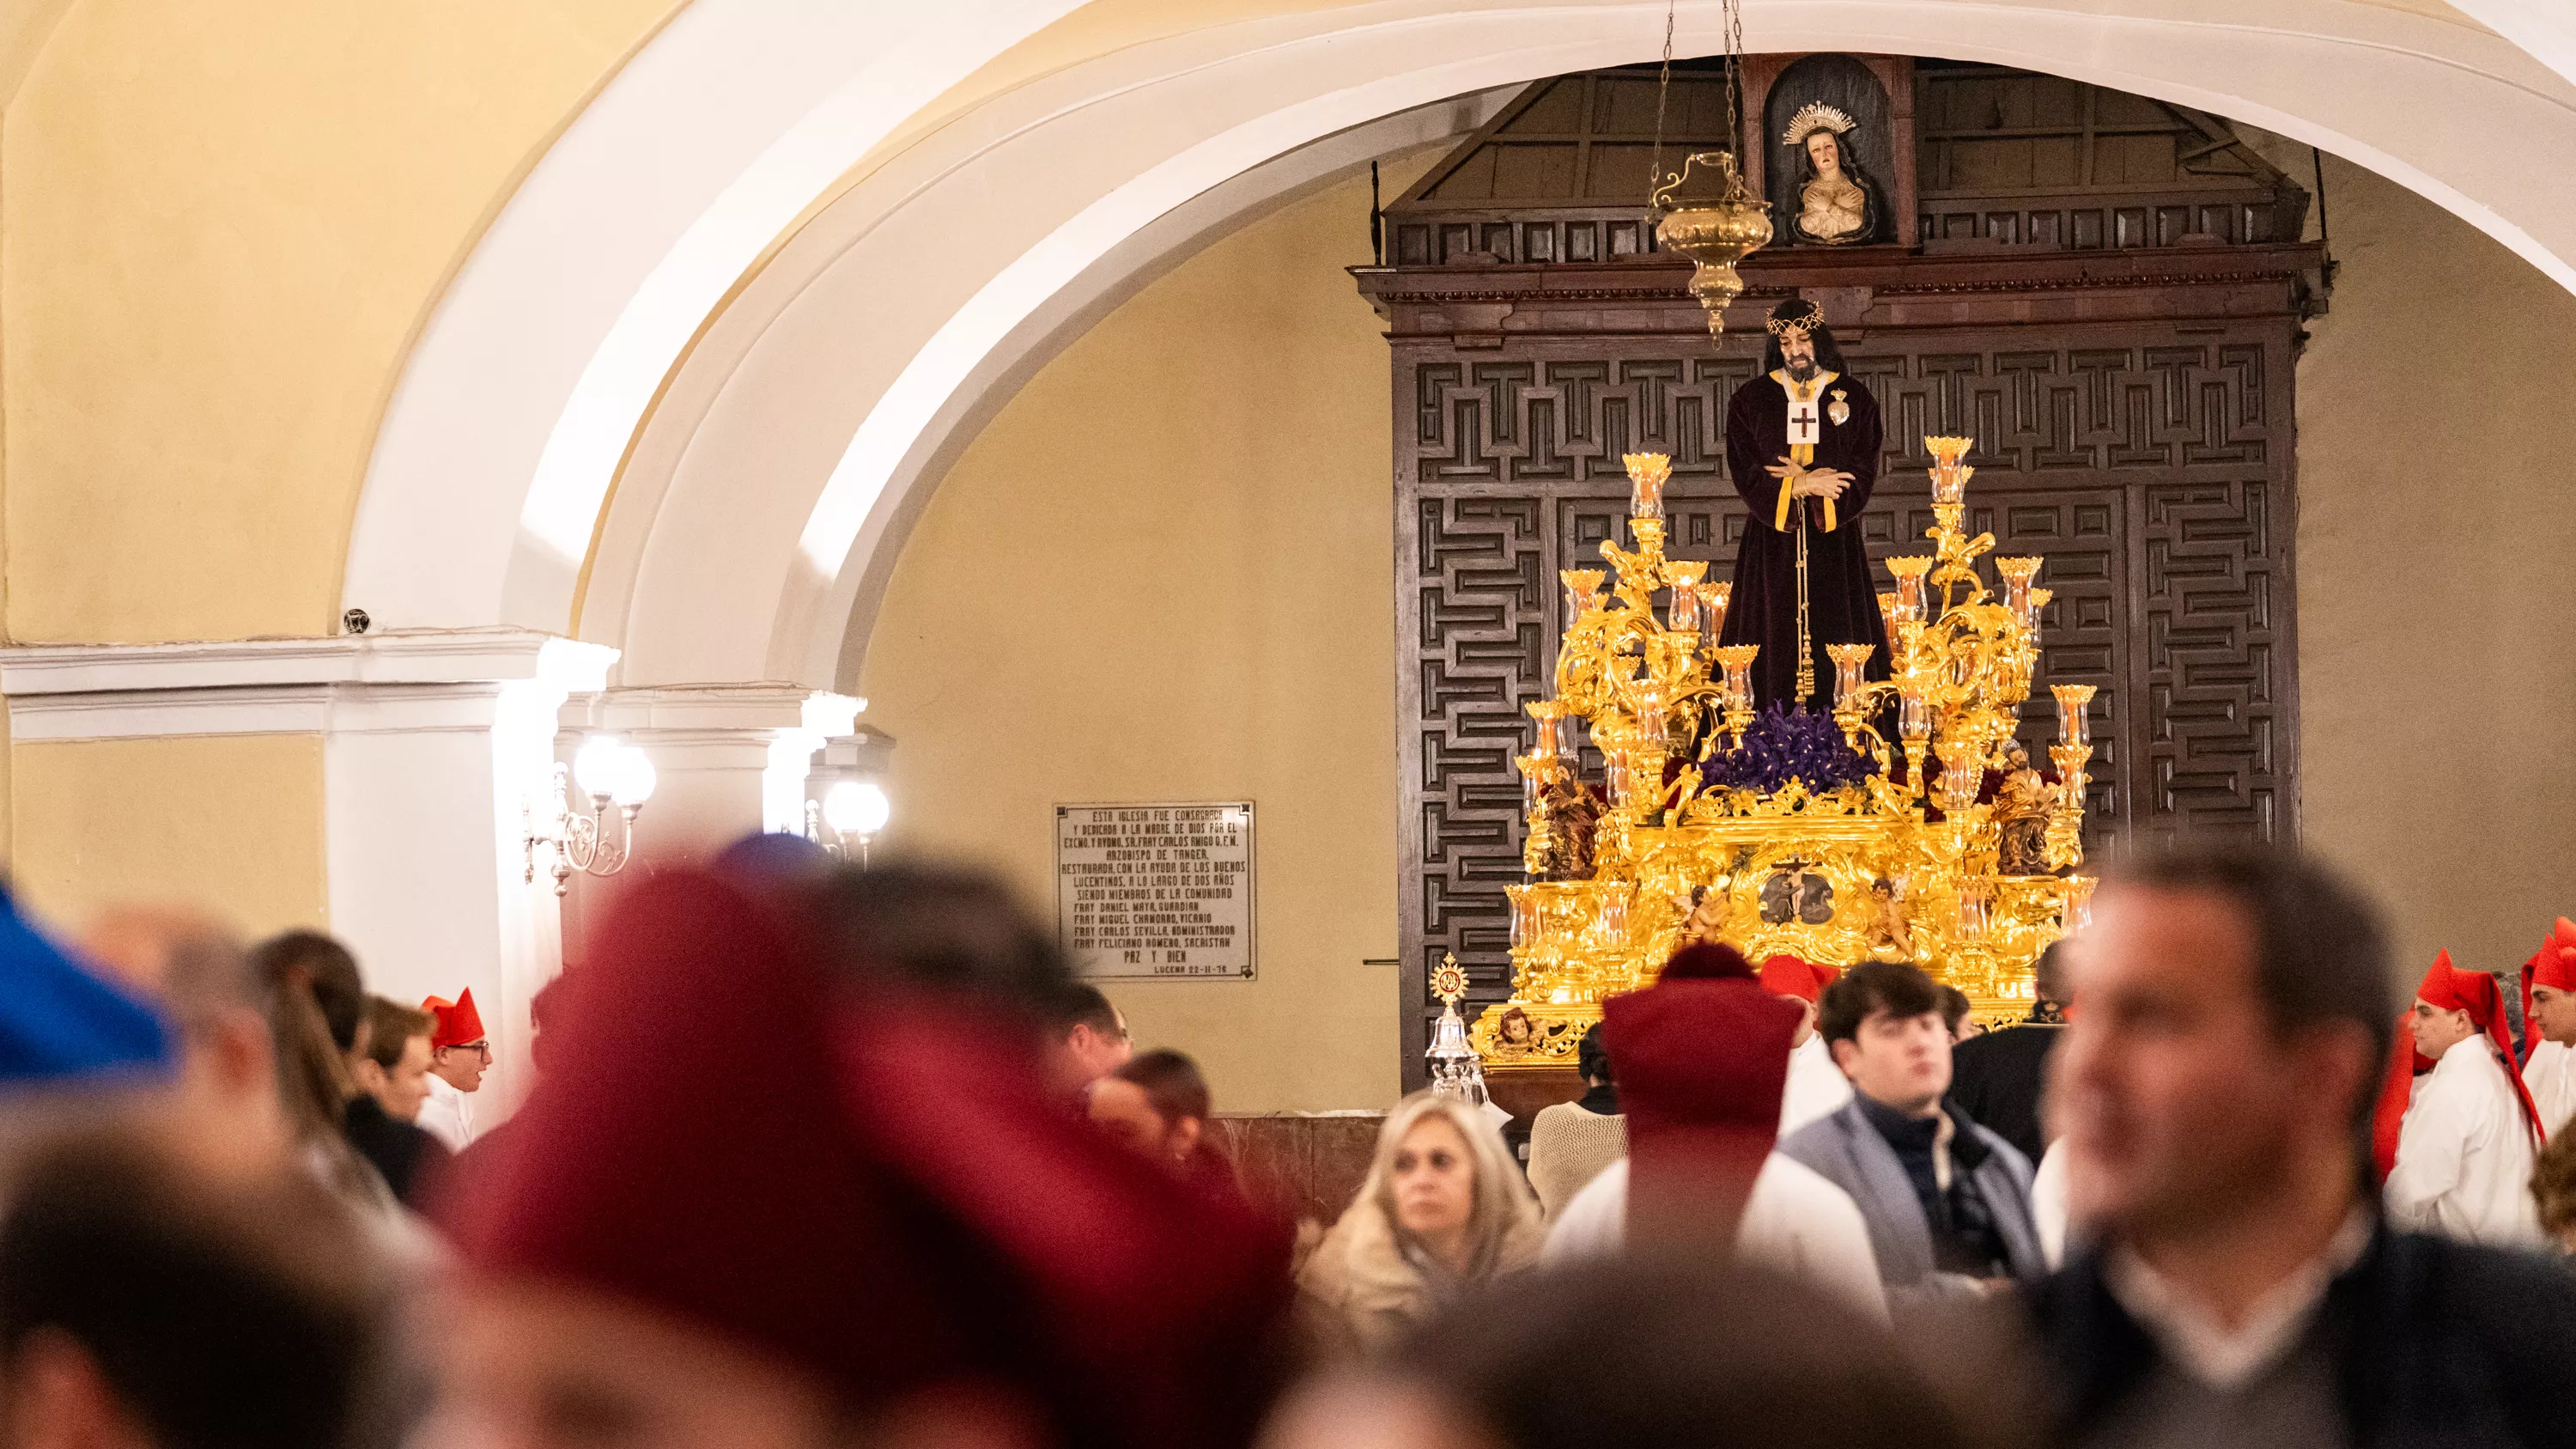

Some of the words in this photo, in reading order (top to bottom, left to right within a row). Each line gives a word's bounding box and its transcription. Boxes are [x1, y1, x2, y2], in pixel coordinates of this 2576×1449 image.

[1092, 811, 1113, 822] ESTA
[1119, 811, 1148, 821] IGLESIA
[1154, 811, 1169, 821] FUE
[1175, 810, 1223, 821] CONSAGRADA
[1073, 825, 1078, 835] Y
[1083, 825, 1117, 835] DEDICADA
[1121, 824, 1126, 834] A
[1131, 824, 1140, 835] LA
[1145, 824, 1170, 834] MADRE
[1175, 824, 1184, 834] DE
[1188, 823, 1205, 833] DIOS
[1210, 823, 1224, 833] POR
[1228, 822, 1237, 833] EL
[1091, 837, 1096, 848] Y
[1158, 836, 1188, 847] CARLOS
[1191, 836, 1213, 847] AMIGO
[1107, 849, 1151, 861] ARZOBISPO
[1157, 849, 1167, 860] DE
[1173, 849, 1209, 860] TANGER.
[1117, 862, 1132, 874] CON
[1136, 862, 1145, 874] LA
[1150, 862, 1176, 873] AYUDA
[1180, 861, 1190, 873] DE
[1194, 861, 1210, 873] LOS
[1214, 861, 1245, 873] BUENOS
[1129, 876, 1133, 886] A
[1137, 875, 1147, 886] LO
[1151, 875, 1177, 886] LARGO
[1181, 875, 1191, 886] DE
[1195, 874, 1210, 886] DOS
[1214, 873, 1234, 886] AÑOS
[1078, 889, 1105, 900] SIENDO
[1109, 889, 1151, 900] MIEMBROS
[1156, 888, 1165, 899] DE
[1170, 888, 1181, 899] LA
[1185, 888, 1232, 899] COMUNIDAD
[1074, 903, 1095, 912] FRAY
[1100, 903, 1129, 912] DANIEL
[1158, 901, 1199, 911] GUARDIAN
[1074, 915, 1095, 924] FRAY
[1099, 914, 1130, 924] MIGUEL
[1181, 913, 1212, 923] VICARIO
[1074, 927, 1095, 936] FRAY
[1098, 927, 1130, 936] CARLOS
[1172, 925, 1235, 935] ADMINISTRADOR
[1074, 939, 1094, 948] FRAY
[1098, 938, 1142, 948] FELICIANO
[1185, 938, 1230, 947] SACRISTAN
[1124, 950, 1140, 963] PAZ
[1151, 950, 1157, 963] Y
[1167, 950, 1186, 962] BIEN
